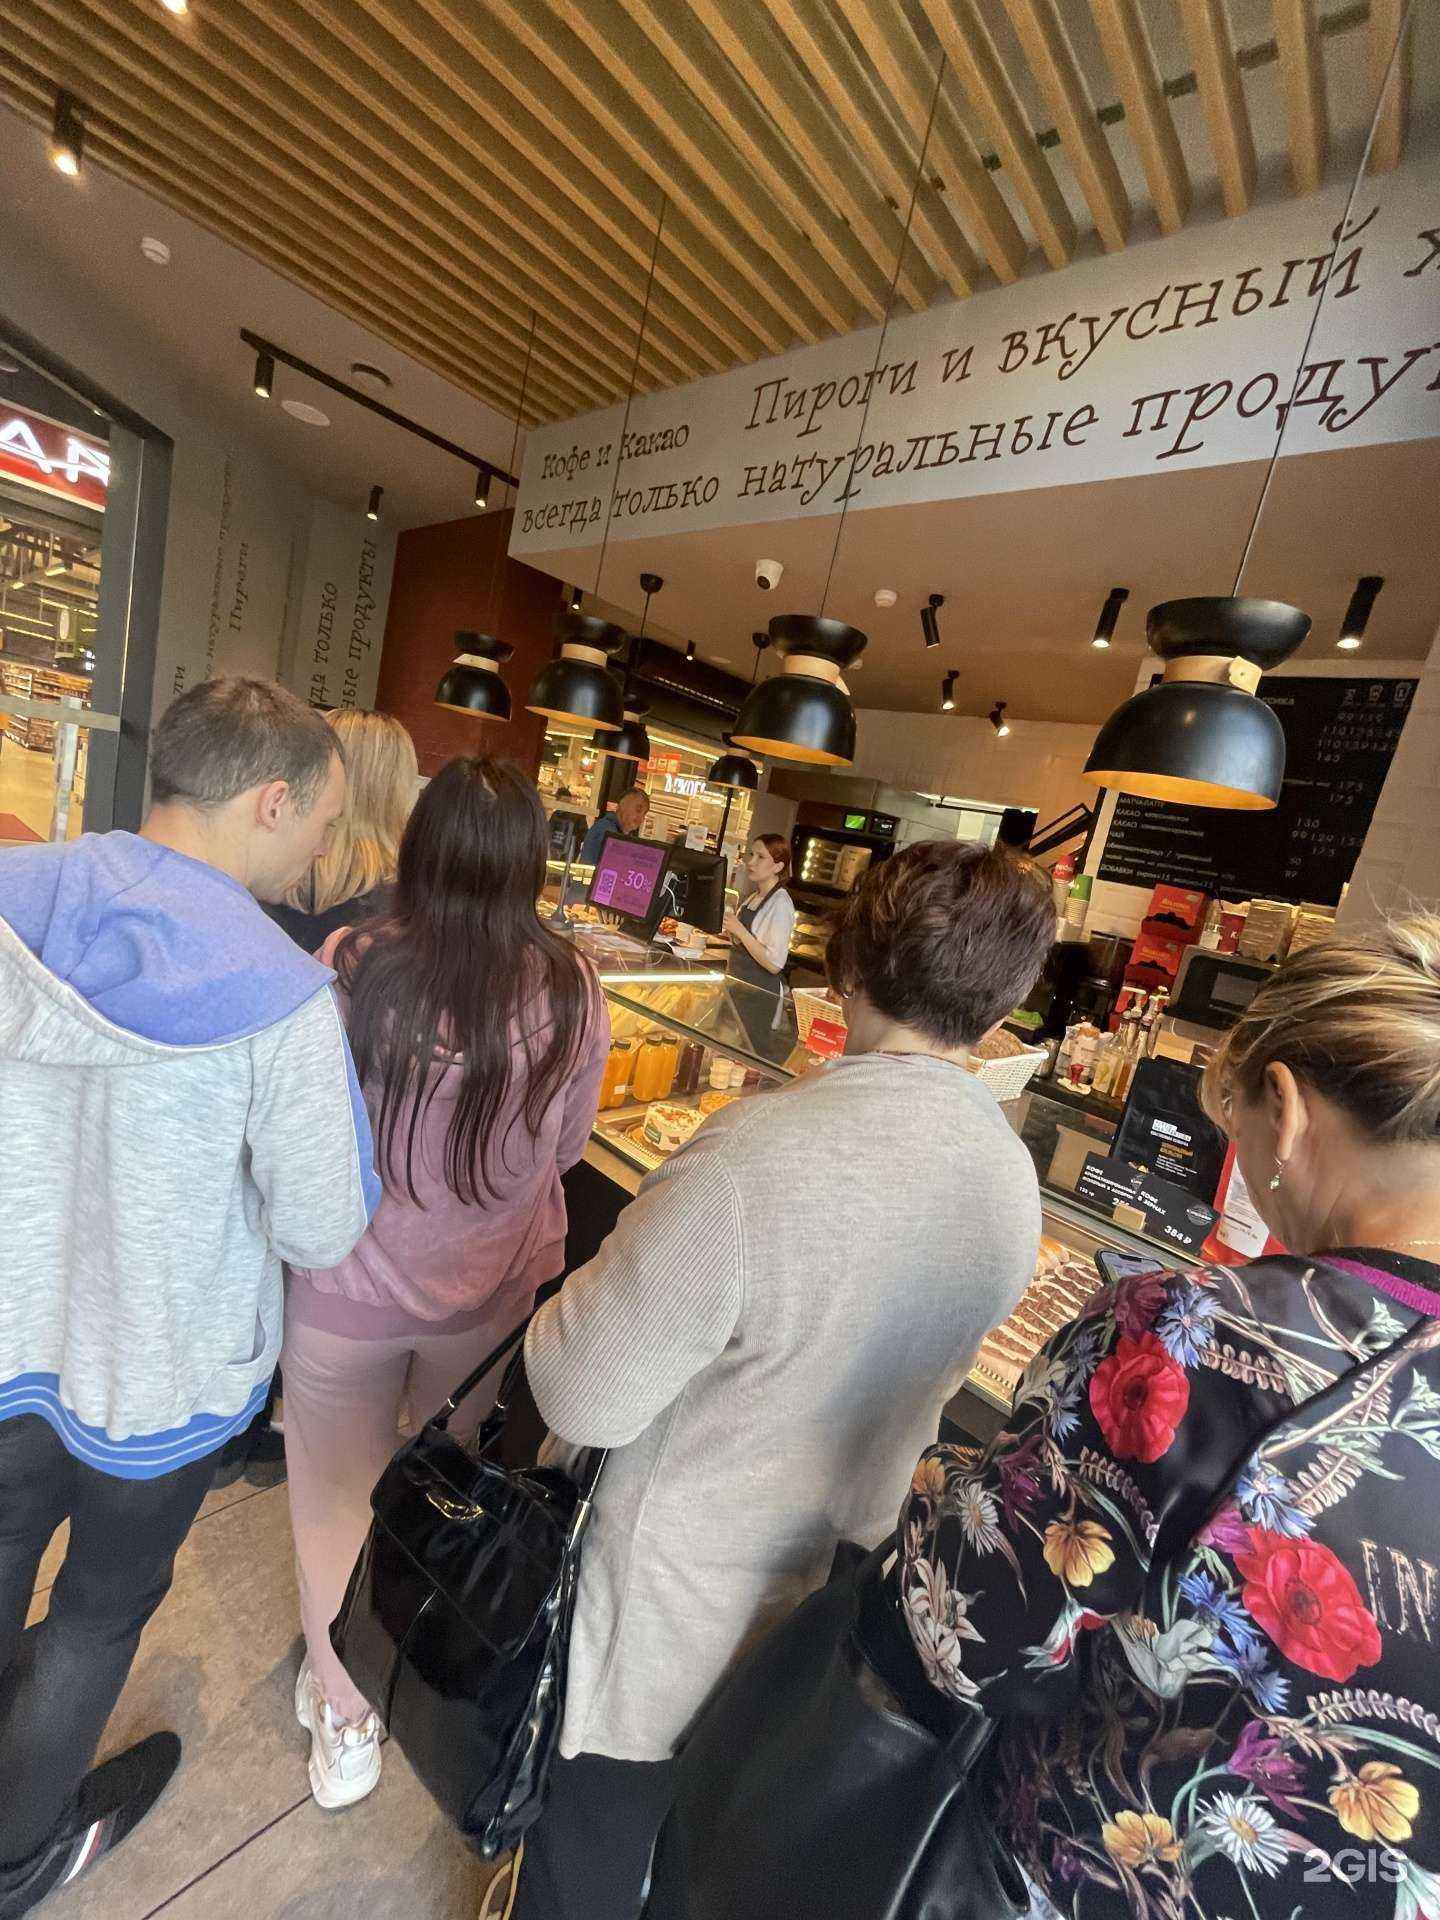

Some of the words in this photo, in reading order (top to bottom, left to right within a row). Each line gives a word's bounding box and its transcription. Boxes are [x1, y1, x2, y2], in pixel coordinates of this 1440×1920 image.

[744, 358, 921, 438] Пироги
[941, 344, 976, 384] и
[997, 206, 1380, 382] вкусный
[737, 404, 1101, 506] натуральные
[1122, 341, 1440, 461] проду
[521, 497, 602, 536] всегда
[611, 475, 721, 520] только
[314, 582, 339, 664] только
[348, 538, 378, 660] продукты
